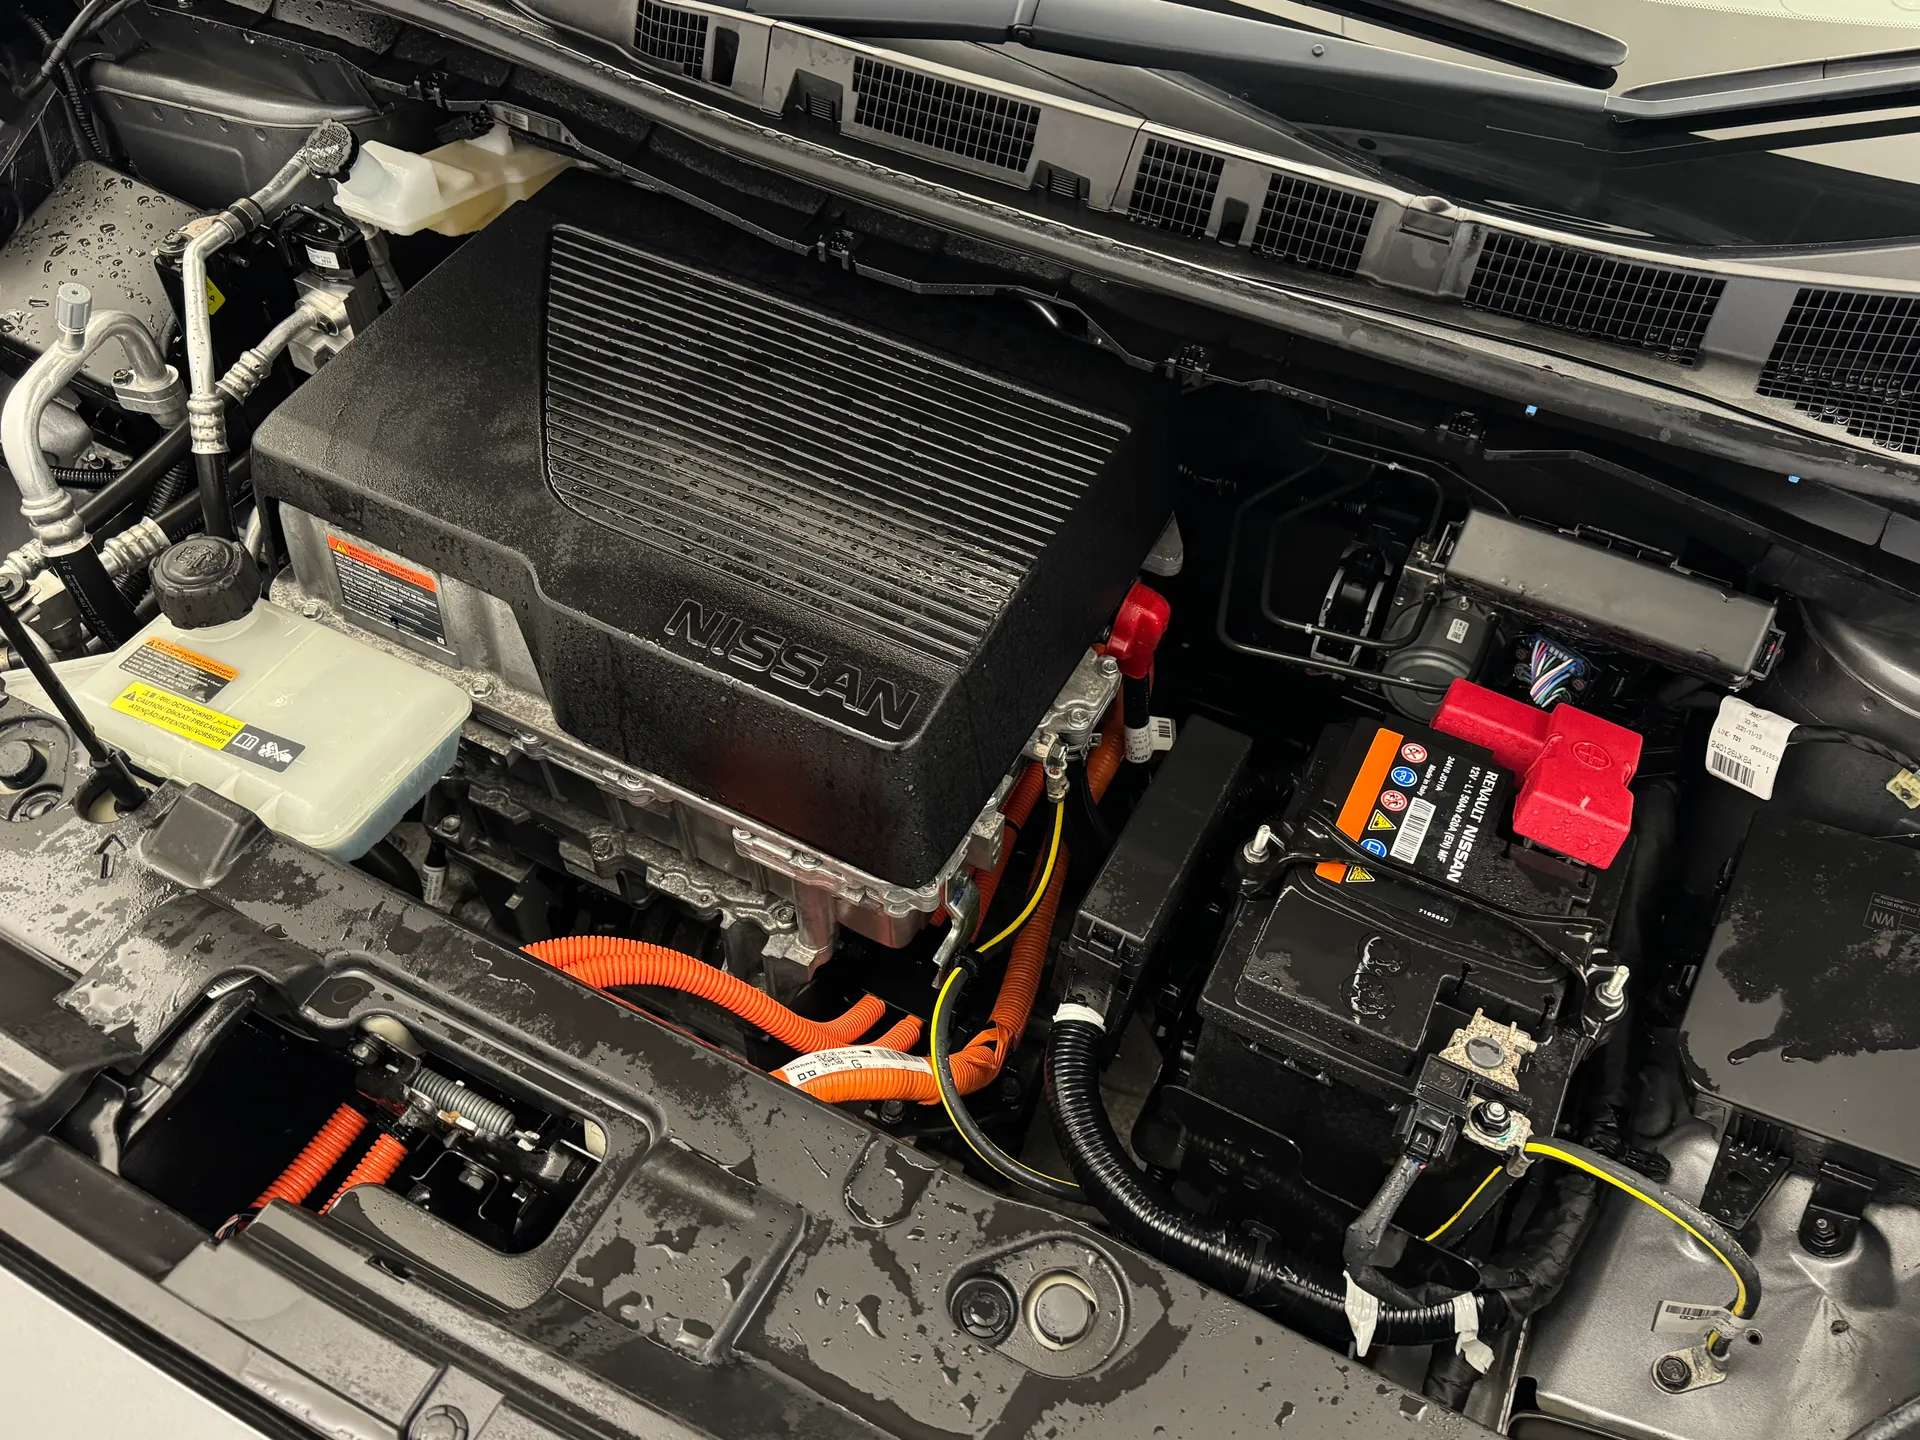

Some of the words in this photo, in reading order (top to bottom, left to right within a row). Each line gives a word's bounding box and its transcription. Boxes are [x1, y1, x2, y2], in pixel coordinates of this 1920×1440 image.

[663, 598, 920, 730] NISSAN
[1425, 764, 1436, 779] Made
[1468, 766, 1481, 781] 12V
[1416, 784, 1428, 797] Italy
[1463, 784, 1474, 794] L1
[1470, 771, 1499, 823] RENAULT
[1455, 794, 1470, 813] 50Ah
[1448, 813, 1462, 832] 420A
[1440, 831, 1455, 849] (EN)
[1437, 849, 1449, 863] MF
[1446, 824, 1479, 883] NISSAN
